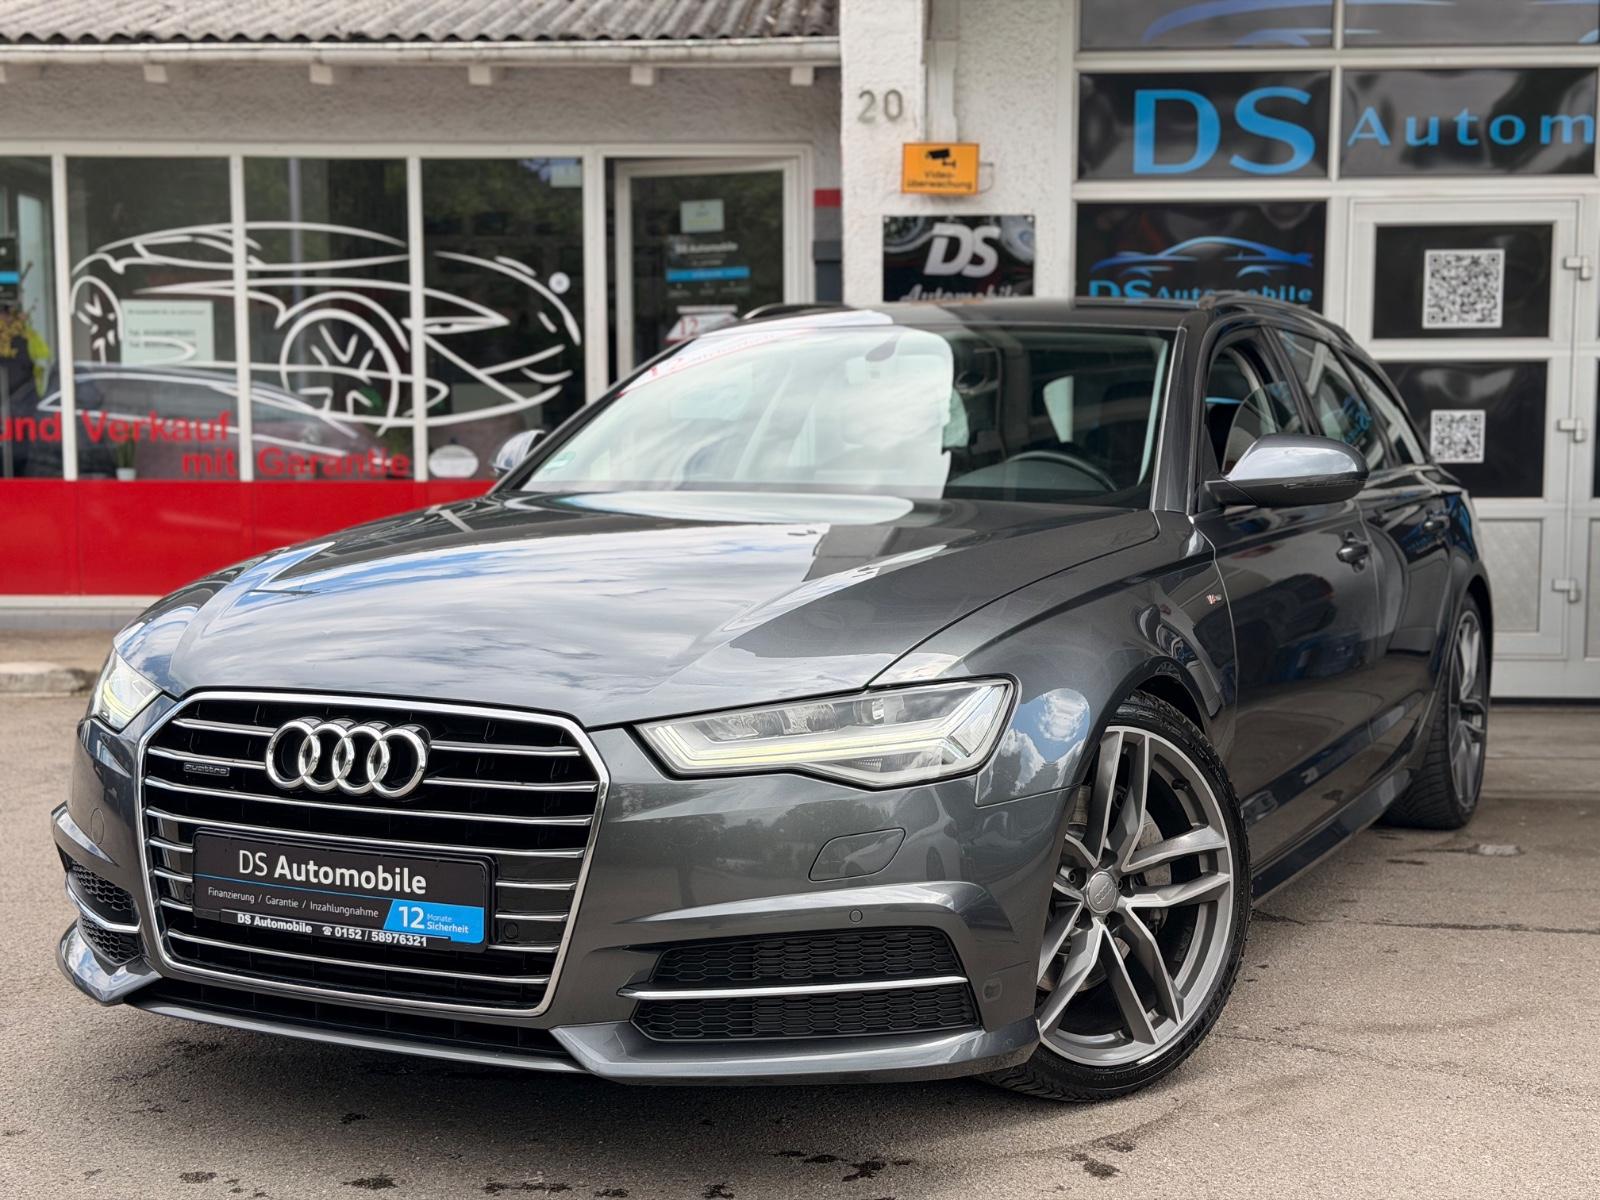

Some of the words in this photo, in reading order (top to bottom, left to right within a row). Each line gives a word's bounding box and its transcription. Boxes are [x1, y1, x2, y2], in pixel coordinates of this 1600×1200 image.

[858, 90, 903, 123] 20
[1133, 86, 1316, 174] DS
[923, 222, 1002, 278] DS
[1088, 280, 1153, 302] DS
[80, 410, 232, 443] Verkauf
[182, 448, 237, 477] mit
[256, 446, 411, 477] Garantie
[239, 849, 269, 877] DS
[273, 854, 427, 895] Automobile
[207, 886, 256, 904] Finanzierung
[265, 895, 300, 908] Garantie
[309, 900, 380, 919] Inzahlungnahme
[398, 906, 425, 930] 12
[426, 912, 453, 923] Monate
[237, 913, 252, 926] DS
[253, 916, 313, 934] Automobile
[334, 926, 363, 940] 0152
[371, 931, 428, 948] 58976321
[426, 921, 470, 935] Sicherheit
